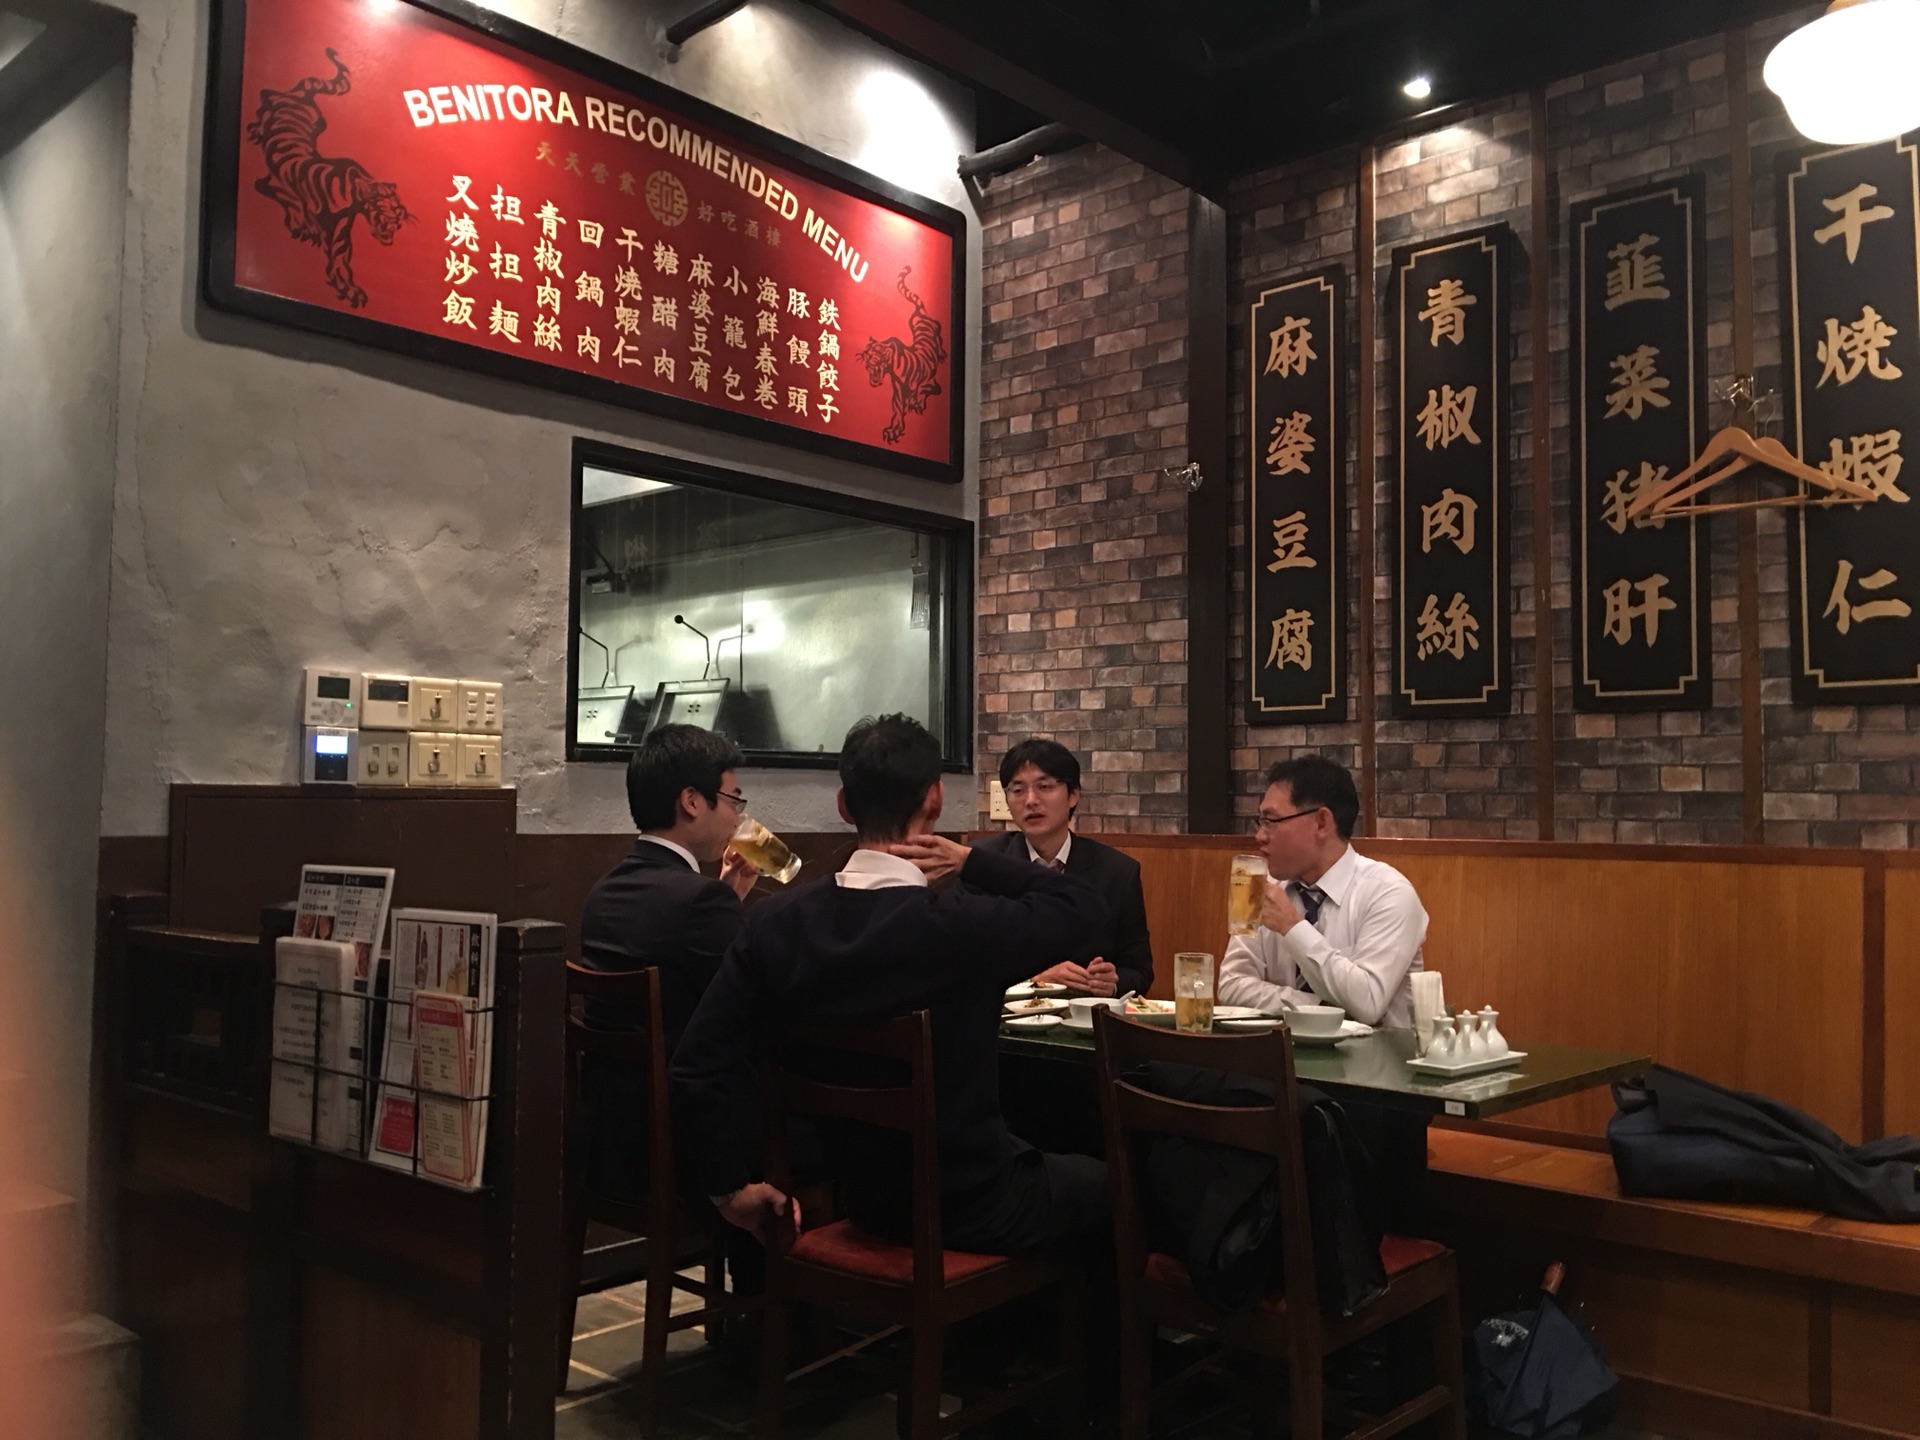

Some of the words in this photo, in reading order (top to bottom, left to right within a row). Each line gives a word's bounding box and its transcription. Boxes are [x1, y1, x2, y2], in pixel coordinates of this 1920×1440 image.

[403, 84, 579, 128] BENITORA
[585, 97, 799, 221] RECOMMENDED
[803, 208, 869, 283] MENU
[533, 200, 566, 352] 青椒肉絲
[575, 219, 605, 363] 回鍋肉
[652, 239, 679, 383] 糖醋肉
[687, 254, 715, 393] 麻婆豆腐
[722, 265, 748, 402] 小籠包
[786, 287, 811, 416] 豚饅頭
[817, 297, 841, 423] 鉄鍋餃子
[1263, 315, 1318, 671] 麻婆豆腐
[1416, 279, 1481, 661] 青椒肉絲
